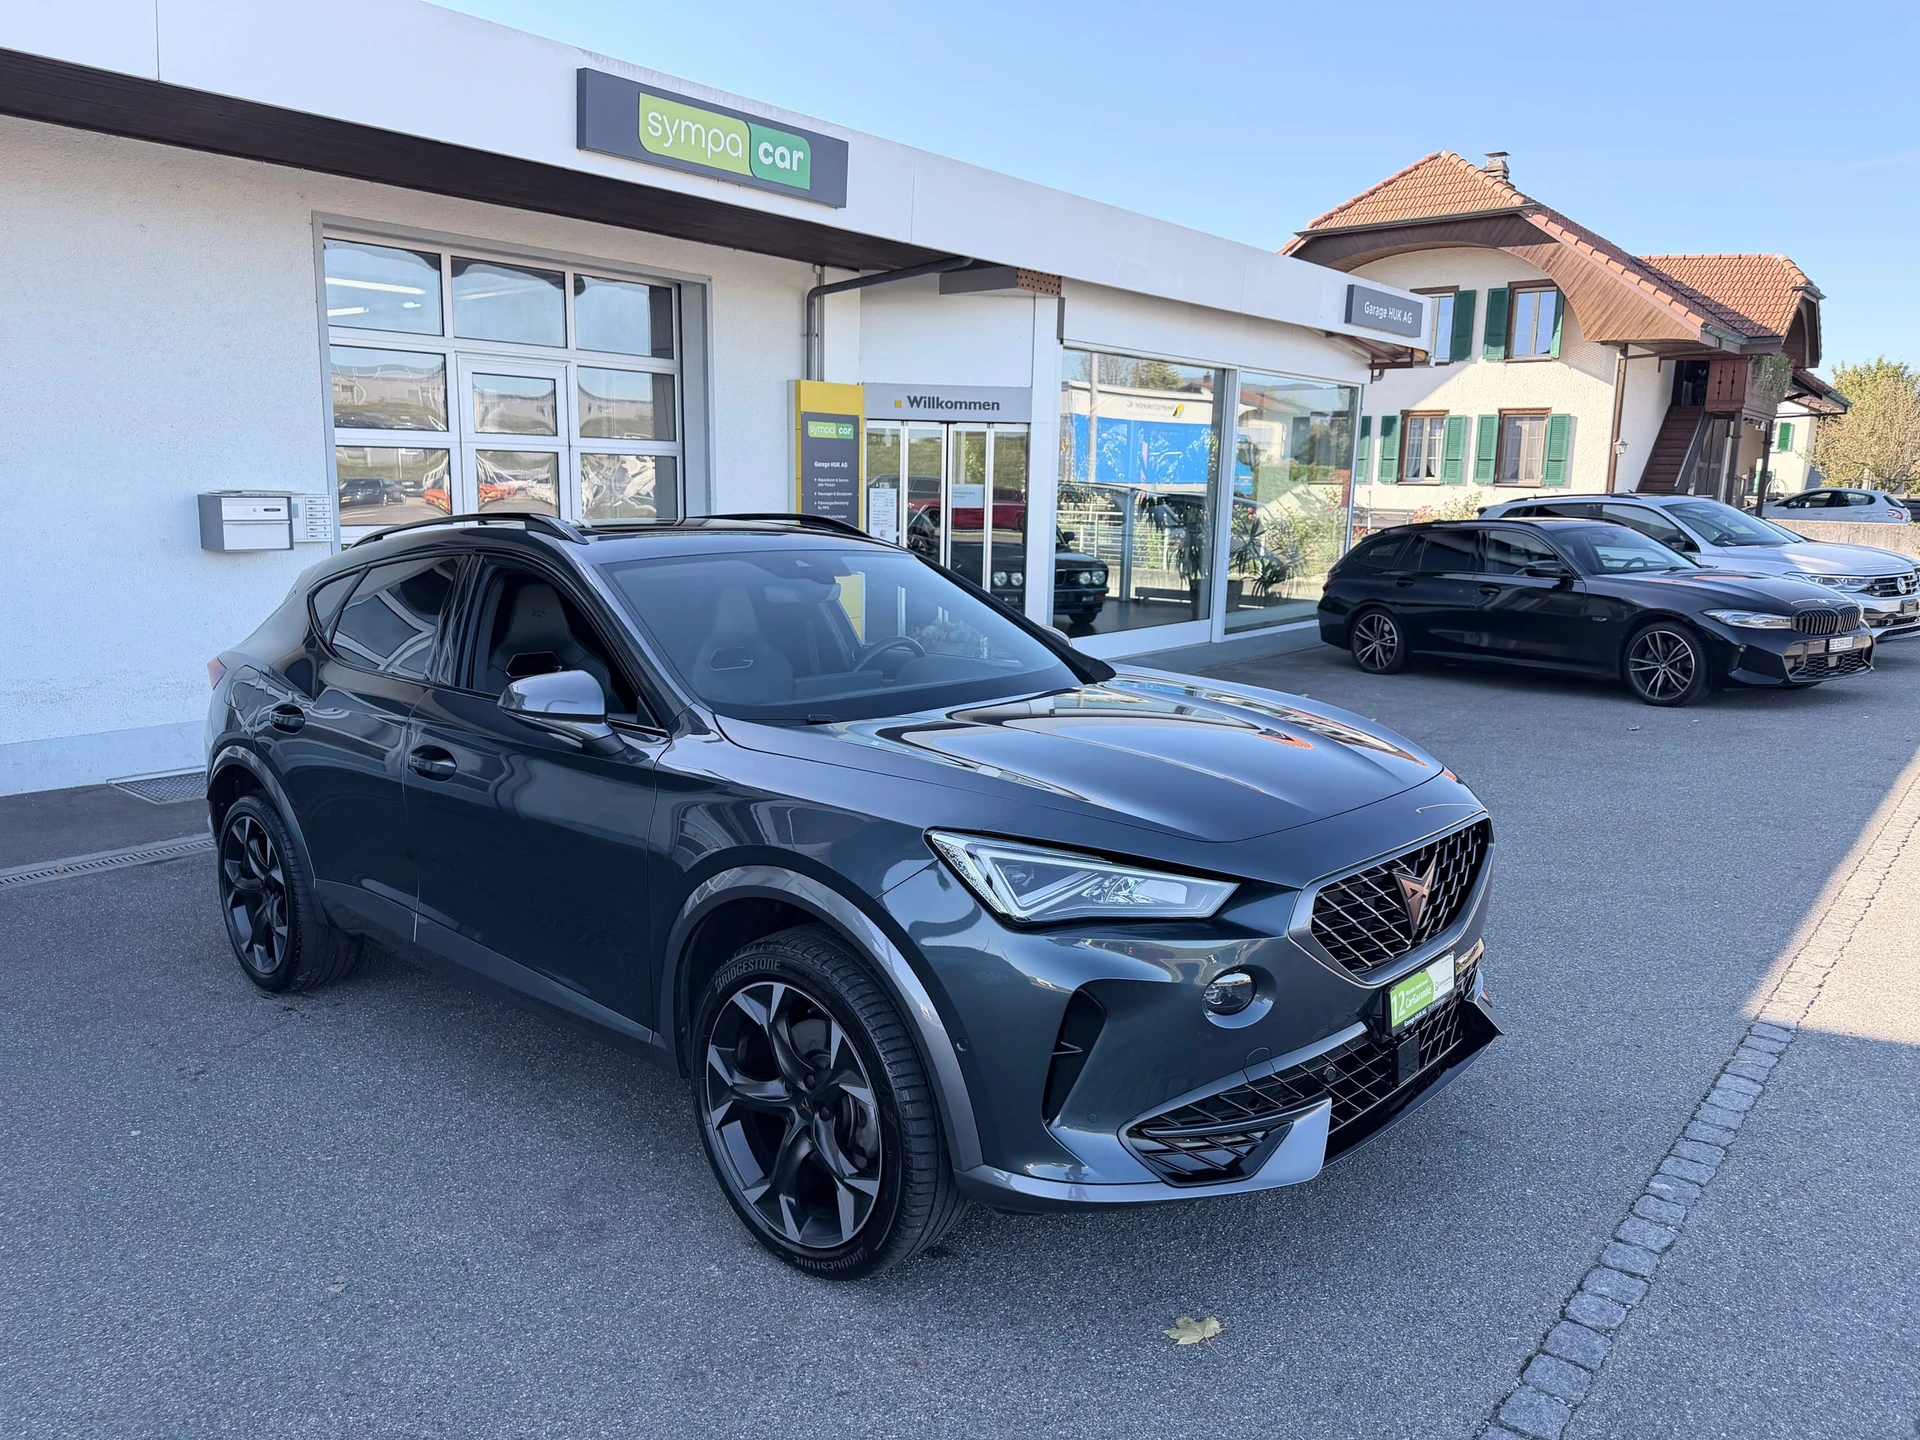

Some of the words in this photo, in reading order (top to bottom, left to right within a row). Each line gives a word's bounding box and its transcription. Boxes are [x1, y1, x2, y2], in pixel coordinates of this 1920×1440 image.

[647, 110, 743, 158] sympa
[758, 141, 804, 172] car
[1364, 301, 1387, 319] Garage
[1388, 307, 1402, 321] HUK
[1403, 311, 1412, 324] AG
[907, 395, 1000, 411] Willkommen
[810, 425, 835, 437] sympa
[838, 427, 852, 435] car
[714, 957, 781, 994] BRIDGESTONE
[1391, 990, 1406, 1020] 12
